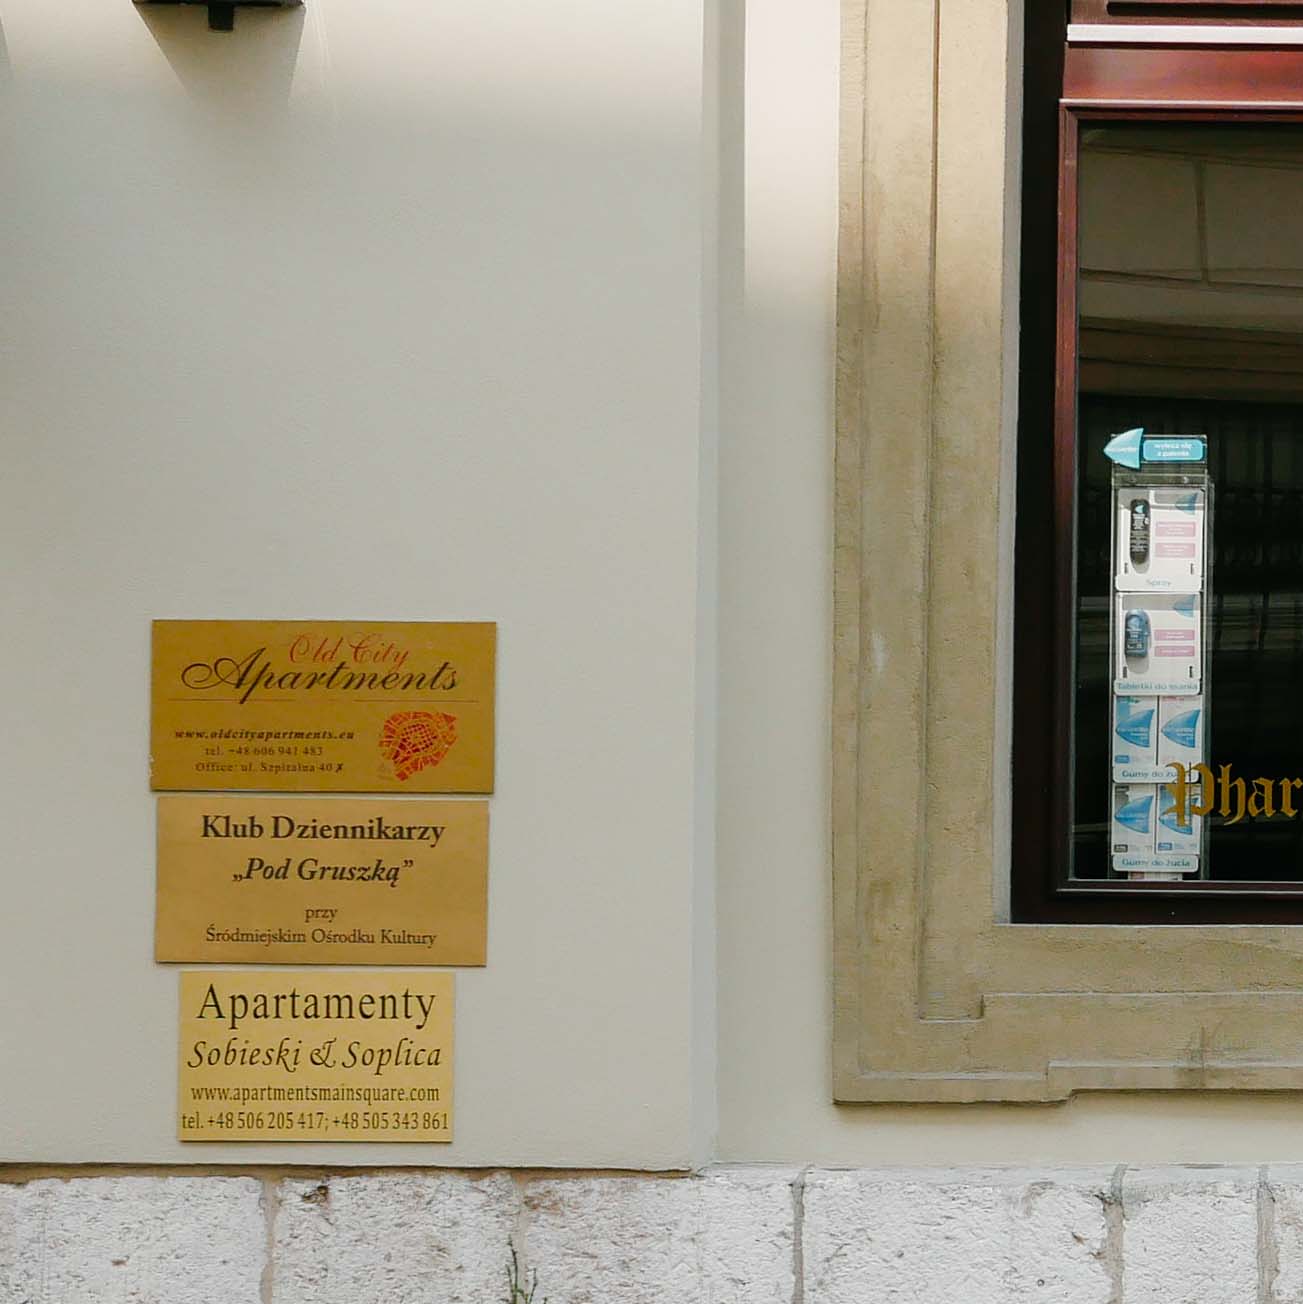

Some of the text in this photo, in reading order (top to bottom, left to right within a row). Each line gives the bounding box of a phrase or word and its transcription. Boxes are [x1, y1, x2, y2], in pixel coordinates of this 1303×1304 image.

[289, 632, 409, 670] Old City
[181, 647, 458, 704] Apartments
[201, 814, 445, 848] Klub Dziennikarzy
[305, 906, 338, 923] przy
[206, 923, 437, 949] Śródmiejskim Ośrodku Kultury
[196, 984, 437, 1030] Apartamenty
[187, 1037, 442, 1076] Sobieski & Soplica
[190, 1084, 440, 1106] www.apartmentsmainsquare.com
[182, 1111, 204, 1130] tel.
[207, 1111, 234, 1130] +48
[237, 1111, 264, 1130] 506
[268, 1111, 294, 1130] 205
[333, 1111, 359, 1130] +48
[363, 1111, 389, 1130] 505
[392, 1111, 419, 1130] 343
[422, 1111, 449, 1130] 861
